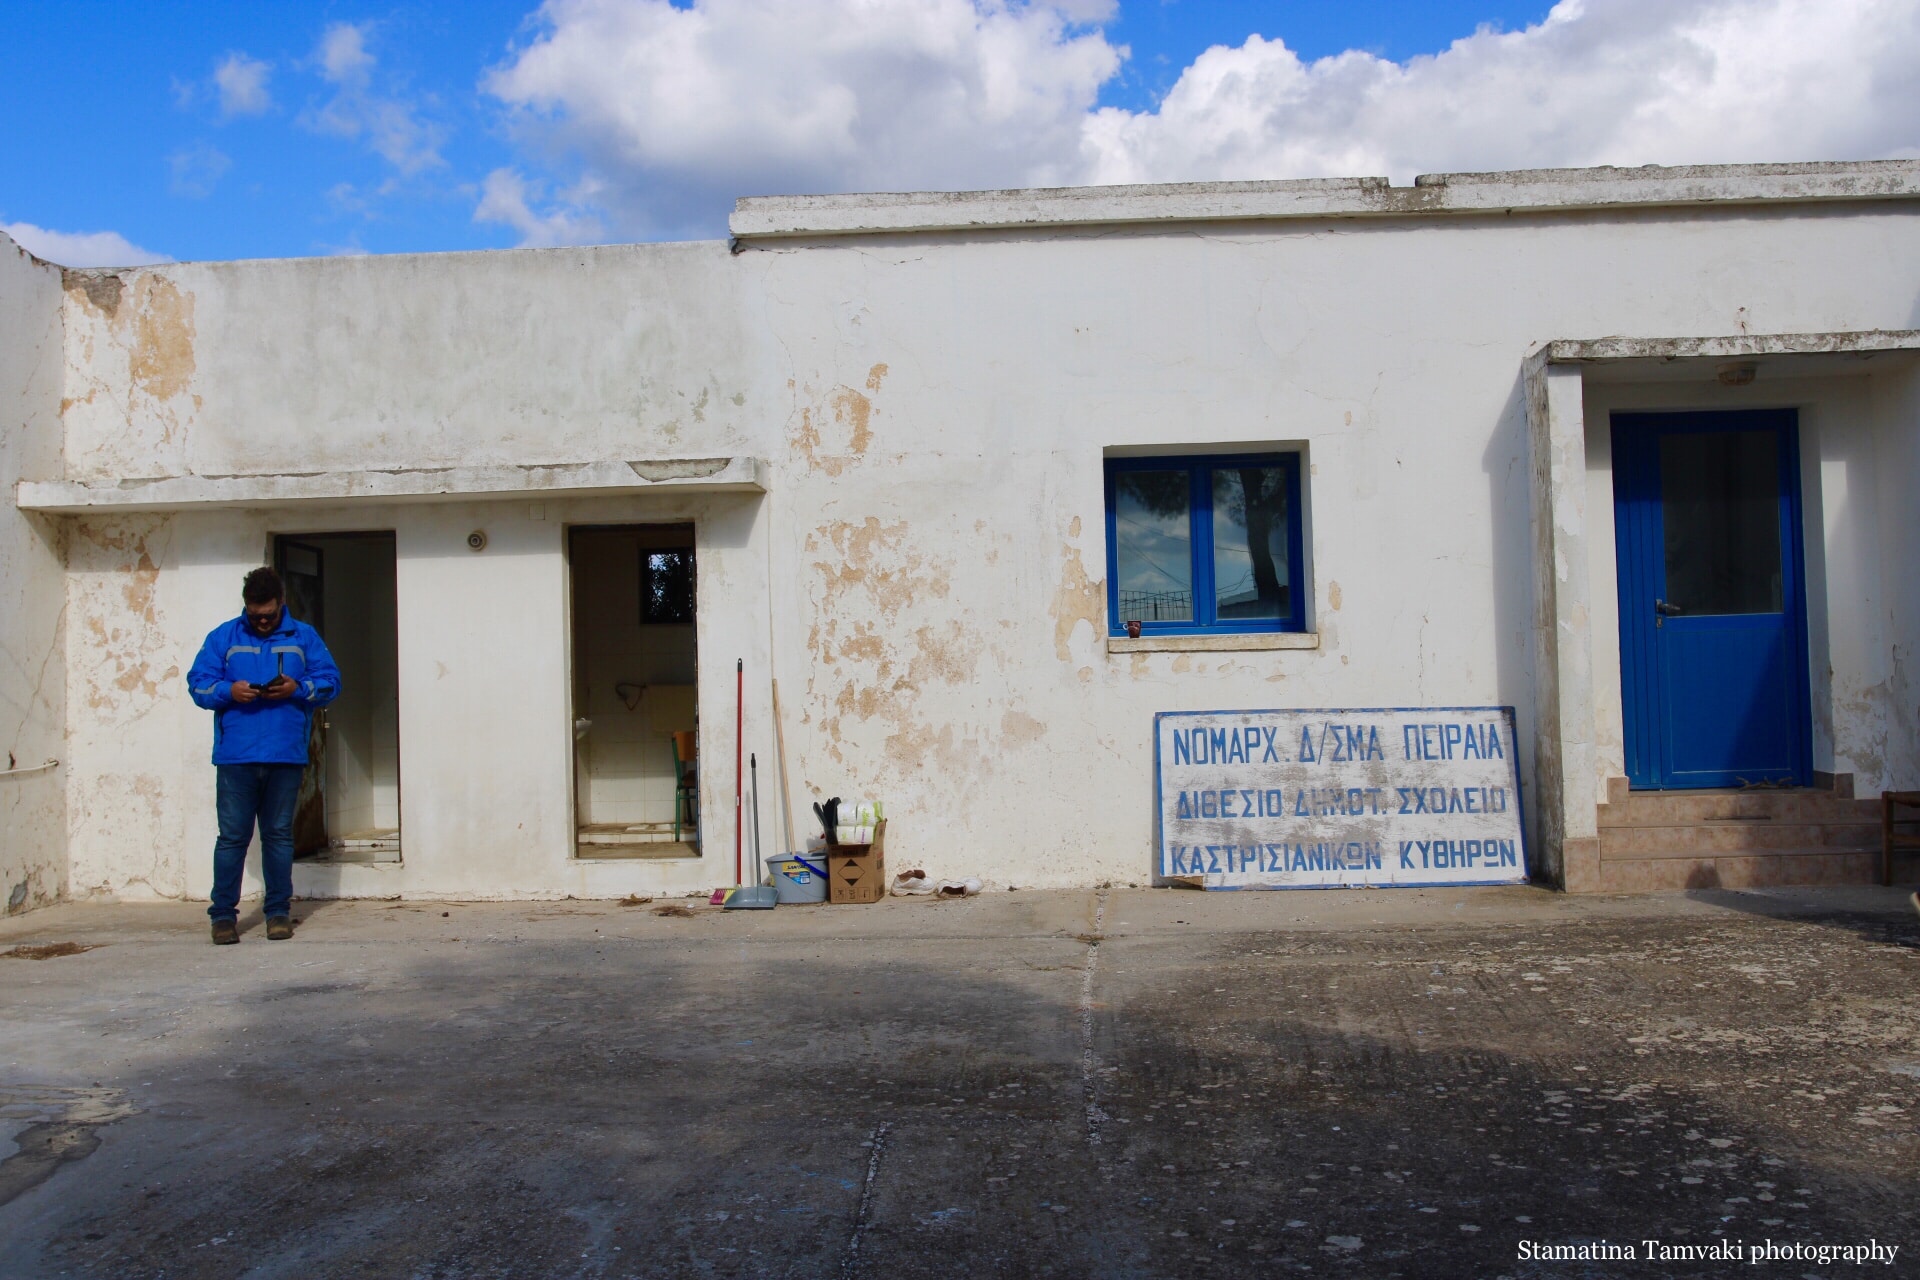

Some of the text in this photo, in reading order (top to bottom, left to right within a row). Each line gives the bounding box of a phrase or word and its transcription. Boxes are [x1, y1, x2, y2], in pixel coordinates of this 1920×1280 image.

[1173, 722, 1504, 766] ΝΟΜΑΡΧ. Δ/ΣΜΑ ΠΕΙΡΑΙΑ
[1176, 788, 1283, 819] ΔΙΘΕΣΙΟ
[1396, 786, 1506, 815] ΣΧΟΛΕΙΟ
[1171, 839, 1517, 874] ΚΑΣΤΡΙΣΙΑΝΙΚΩΝ ΚΥΘΗΡΩΝ
